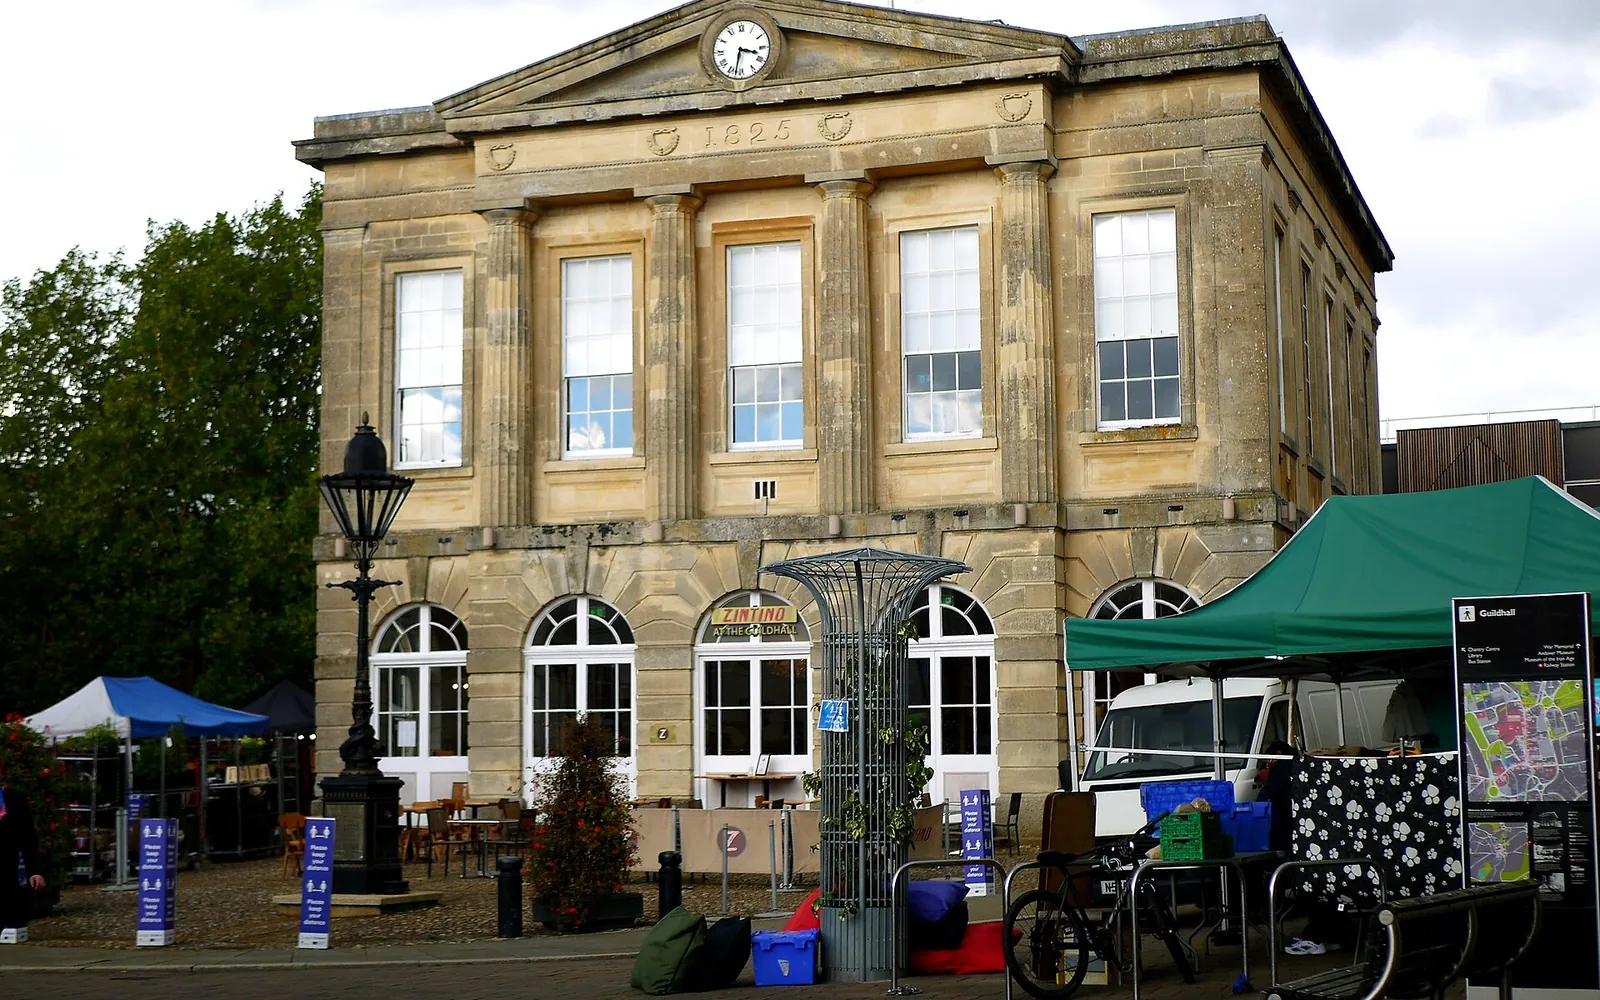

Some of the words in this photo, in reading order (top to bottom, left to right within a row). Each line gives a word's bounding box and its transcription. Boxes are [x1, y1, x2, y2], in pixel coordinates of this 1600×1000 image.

[705, 119, 791, 148] 1825
[722, 607, 786, 623] ZINTINO
[1479, 609, 1516, 617] Guildhall
[713, 627, 724, 636] AT
[726, 626, 744, 636] THE
[745, 625, 798, 636] GUILDHALL
[659, 729, 668, 739] Z
[727, 830, 740, 852] Z
